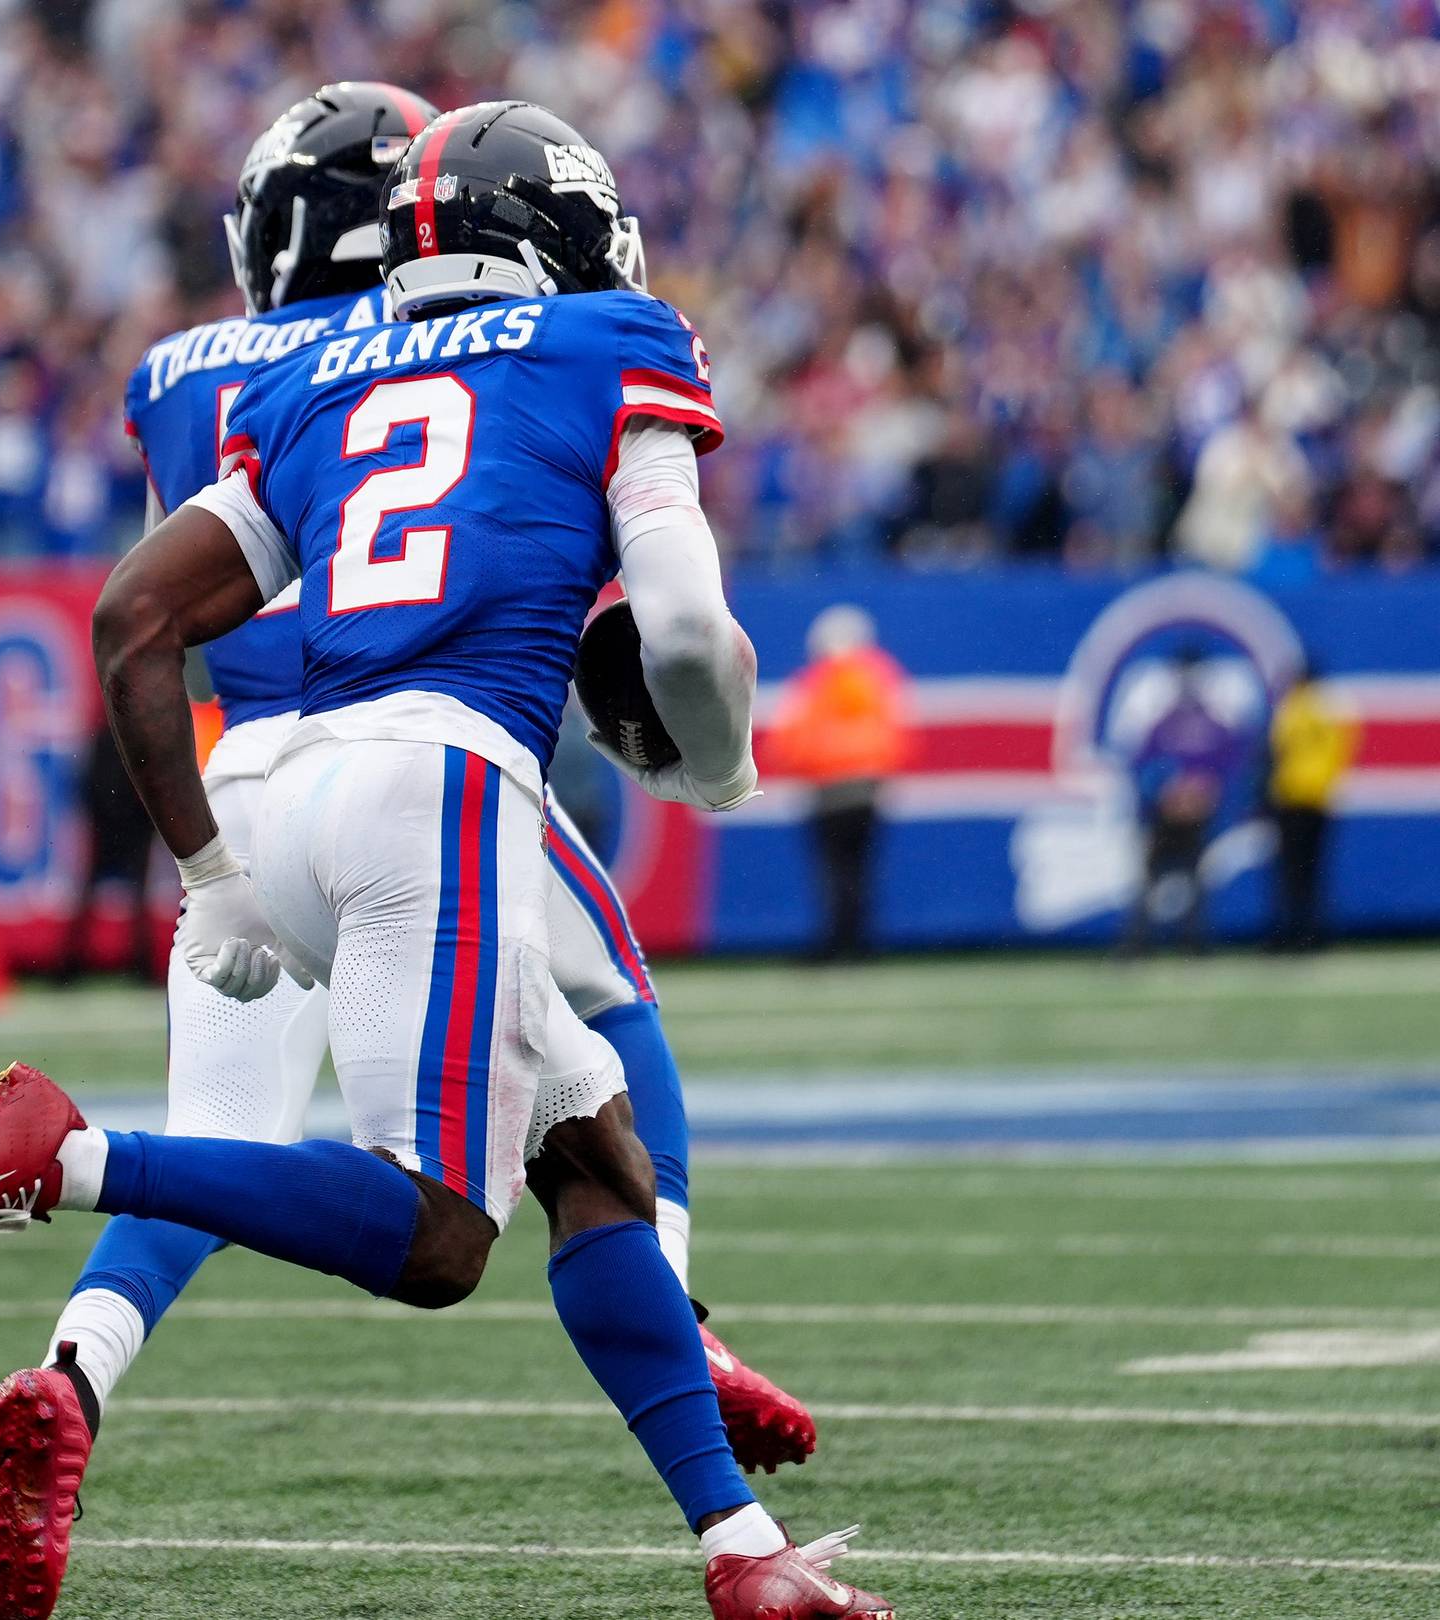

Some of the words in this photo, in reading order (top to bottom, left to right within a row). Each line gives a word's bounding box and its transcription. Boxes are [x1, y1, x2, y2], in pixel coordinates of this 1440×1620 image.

[418, 223, 433, 248] 2
[310, 304, 543, 385] BANKS
[328, 371, 476, 616] 2
